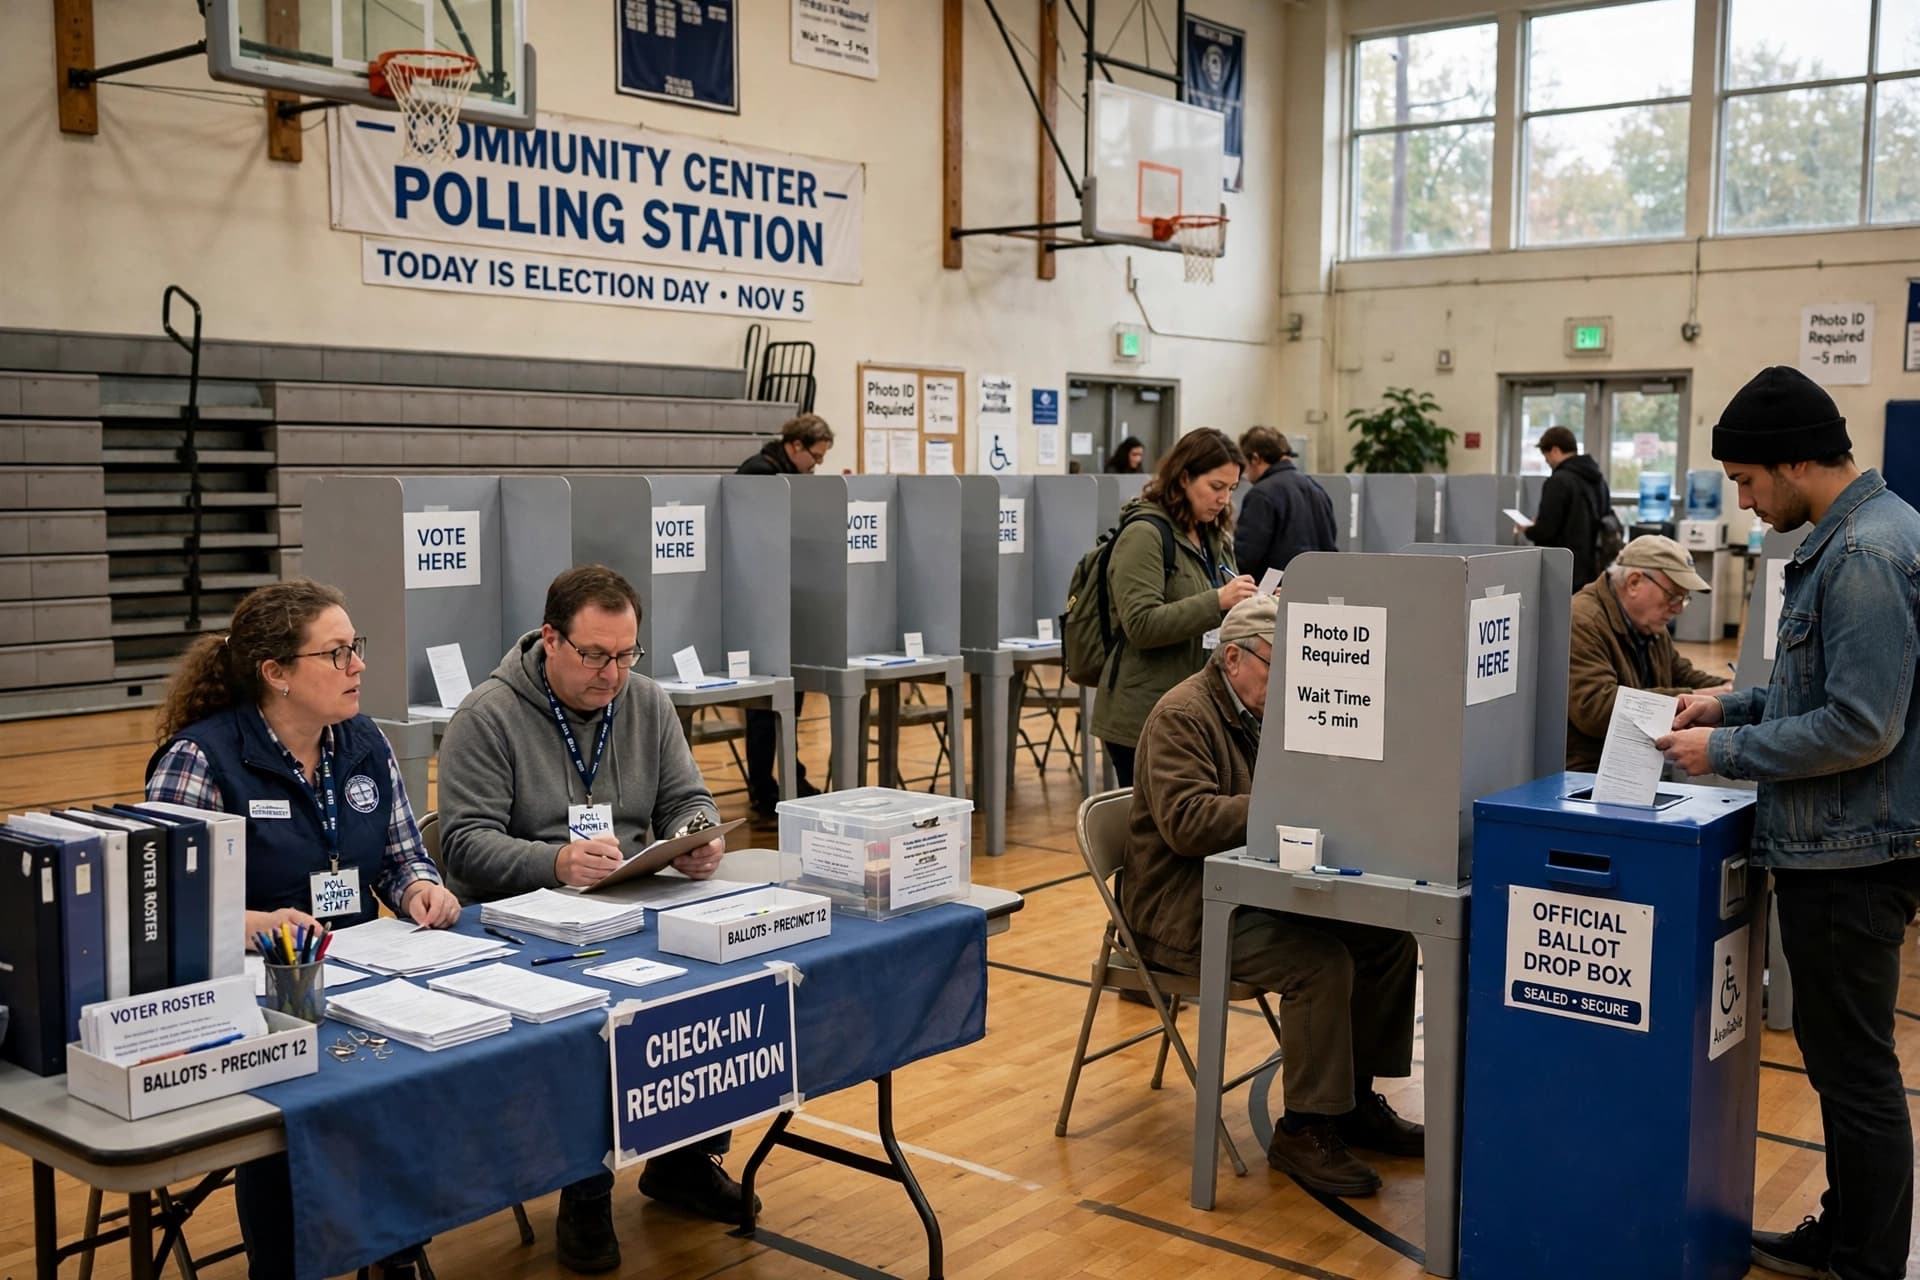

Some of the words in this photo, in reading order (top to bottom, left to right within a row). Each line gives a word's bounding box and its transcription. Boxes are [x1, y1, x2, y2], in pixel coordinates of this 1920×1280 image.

[684, 153, 817, 208] CENTER
[394, 165, 625, 244] POLLING
[643, 200, 823, 266] STATION
[377, 249, 479, 283] TODAY
[489, 260, 514, 287] IS
[525, 265, 654, 300] ELECTION
[664, 279, 709, 305] DAY
[738, 285, 786, 311] NOV
[792, 291, 805, 312] 5
[1810, 314, 1847, 327] Photo
[1851, 313, 1865, 326] ID
[1808, 329, 1865, 346] Required
[1833, 351, 1857, 364] min
[868, 382, 899, 397] Photo
[903, 384, 915, 398] ID
[867, 401, 914, 419] Required
[656, 520, 694, 537] VOTE
[1000, 511, 1016, 524] OTE
[417, 527, 466, 546] VOTE
[1000, 529, 1016, 542] ERE
[418, 552, 467, 571] HERE
[655, 542, 695, 559] HERE
[1303, 623, 1348, 642] Photo
[1353, 626, 1370, 642] ID
[1479, 617, 1510, 645] VOTE
[1302, 646, 1370, 666] Required
[1477, 650, 1509, 678] HERE
[1297, 686, 1330, 703] Wait
[1334, 689, 1371, 706] Time
[1308, 711, 1327, 726] ~5
[1331, 712, 1358, 728] min
[144, 841, 157, 889] VOTER
[144, 891, 158, 942] ROSTER
[728, 924, 767, 945] BALLOTS
[774, 911, 815, 933] PRECINCT
[817, 908, 827, 922] 12
[1533, 902, 1627, 934] OFFICIAL
[1538, 928, 1620, 958] BALLOT
[1524, 952, 1581, 977] DROP
[1588, 964, 1632, 987] BOX
[111, 1003, 158, 1024] VOTER
[162, 990, 216, 1014] ROSTER
[1524, 987, 1568, 1006] SEALED
[1581, 998, 1629, 1017] SECURE
[646, 1008, 752, 1068] CHECK-IN
[756, 1003, 765, 1038] /
[143, 1063, 207, 1093] BALLOTS
[221, 1043, 288, 1074] PRECINCT
[291, 1039, 307, 1056] 12
[626, 1042, 785, 1122] REGISTRATION
